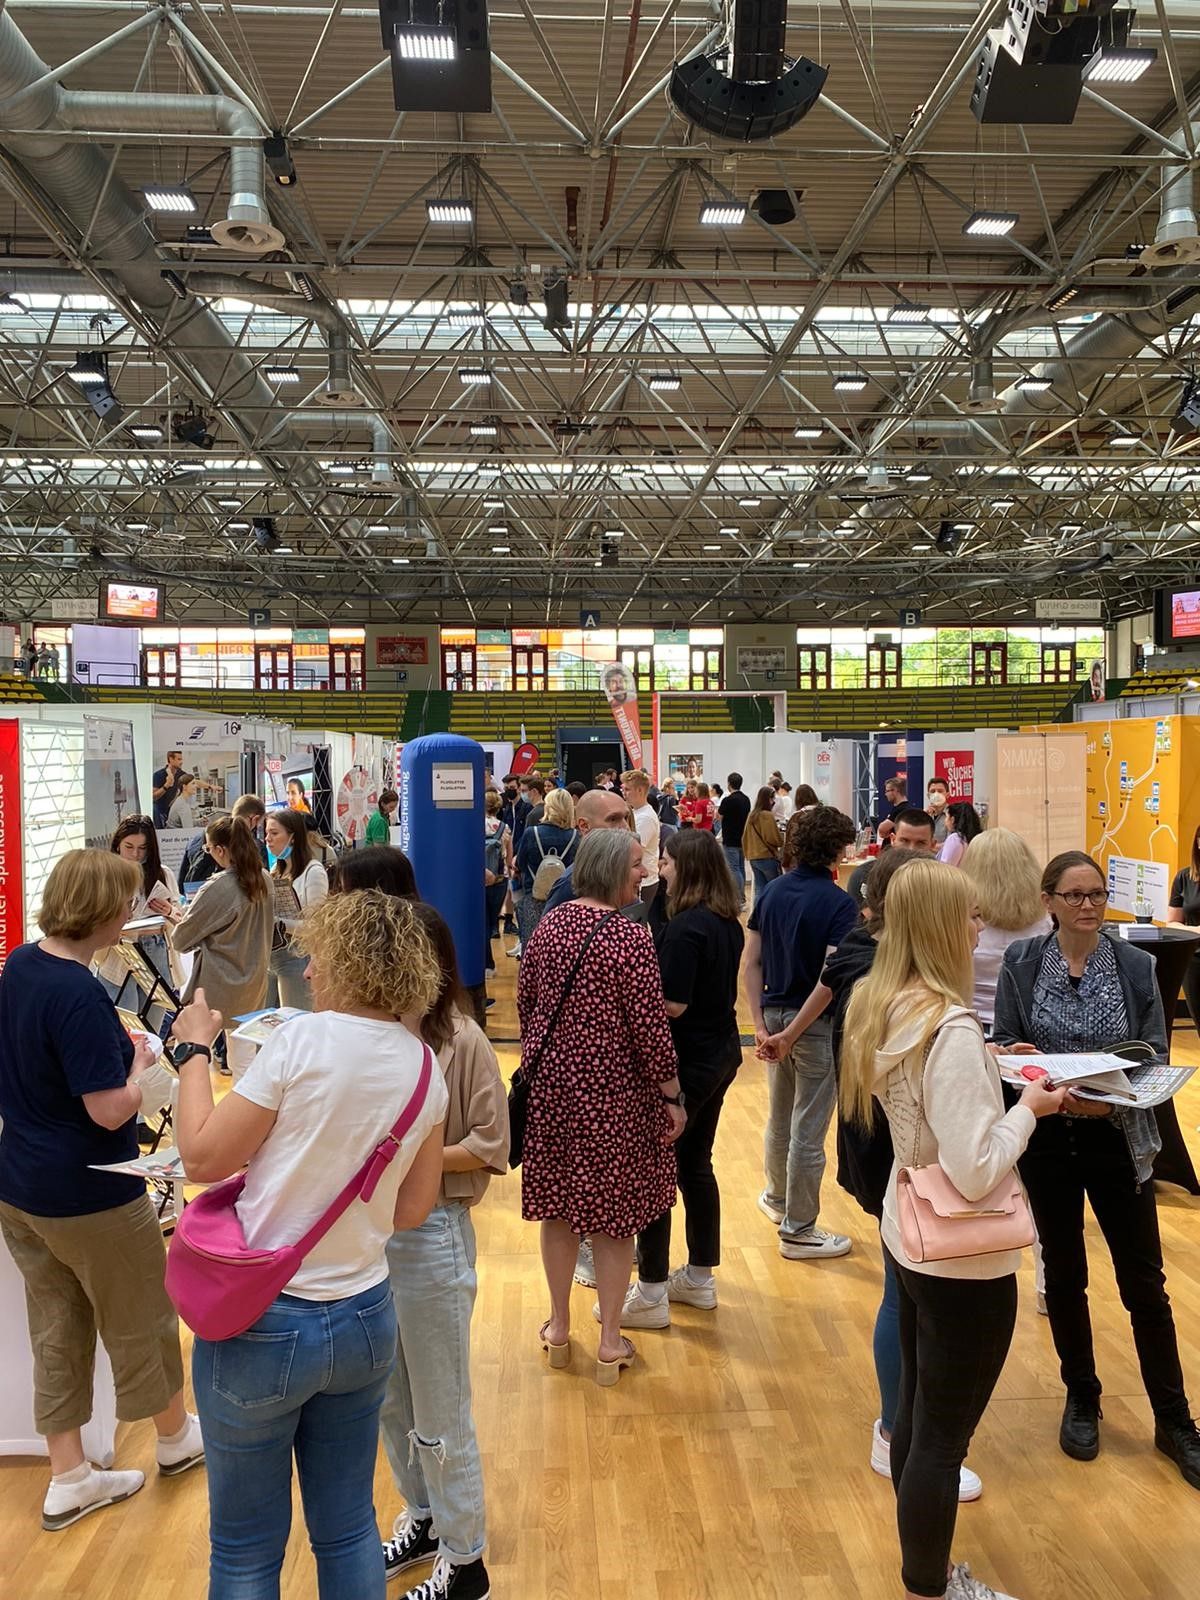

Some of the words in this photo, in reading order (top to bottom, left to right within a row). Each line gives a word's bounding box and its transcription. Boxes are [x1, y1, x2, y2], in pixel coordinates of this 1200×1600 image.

[254, 613, 265, 626] P
[585, 614, 596, 627] A
[905, 612, 916, 625] B
[224, 721, 238, 735] 16
[270, 761, 280, 769] 08
[942, 757, 956, 769] WIR
[402, 771, 411, 852] lugsicherung
